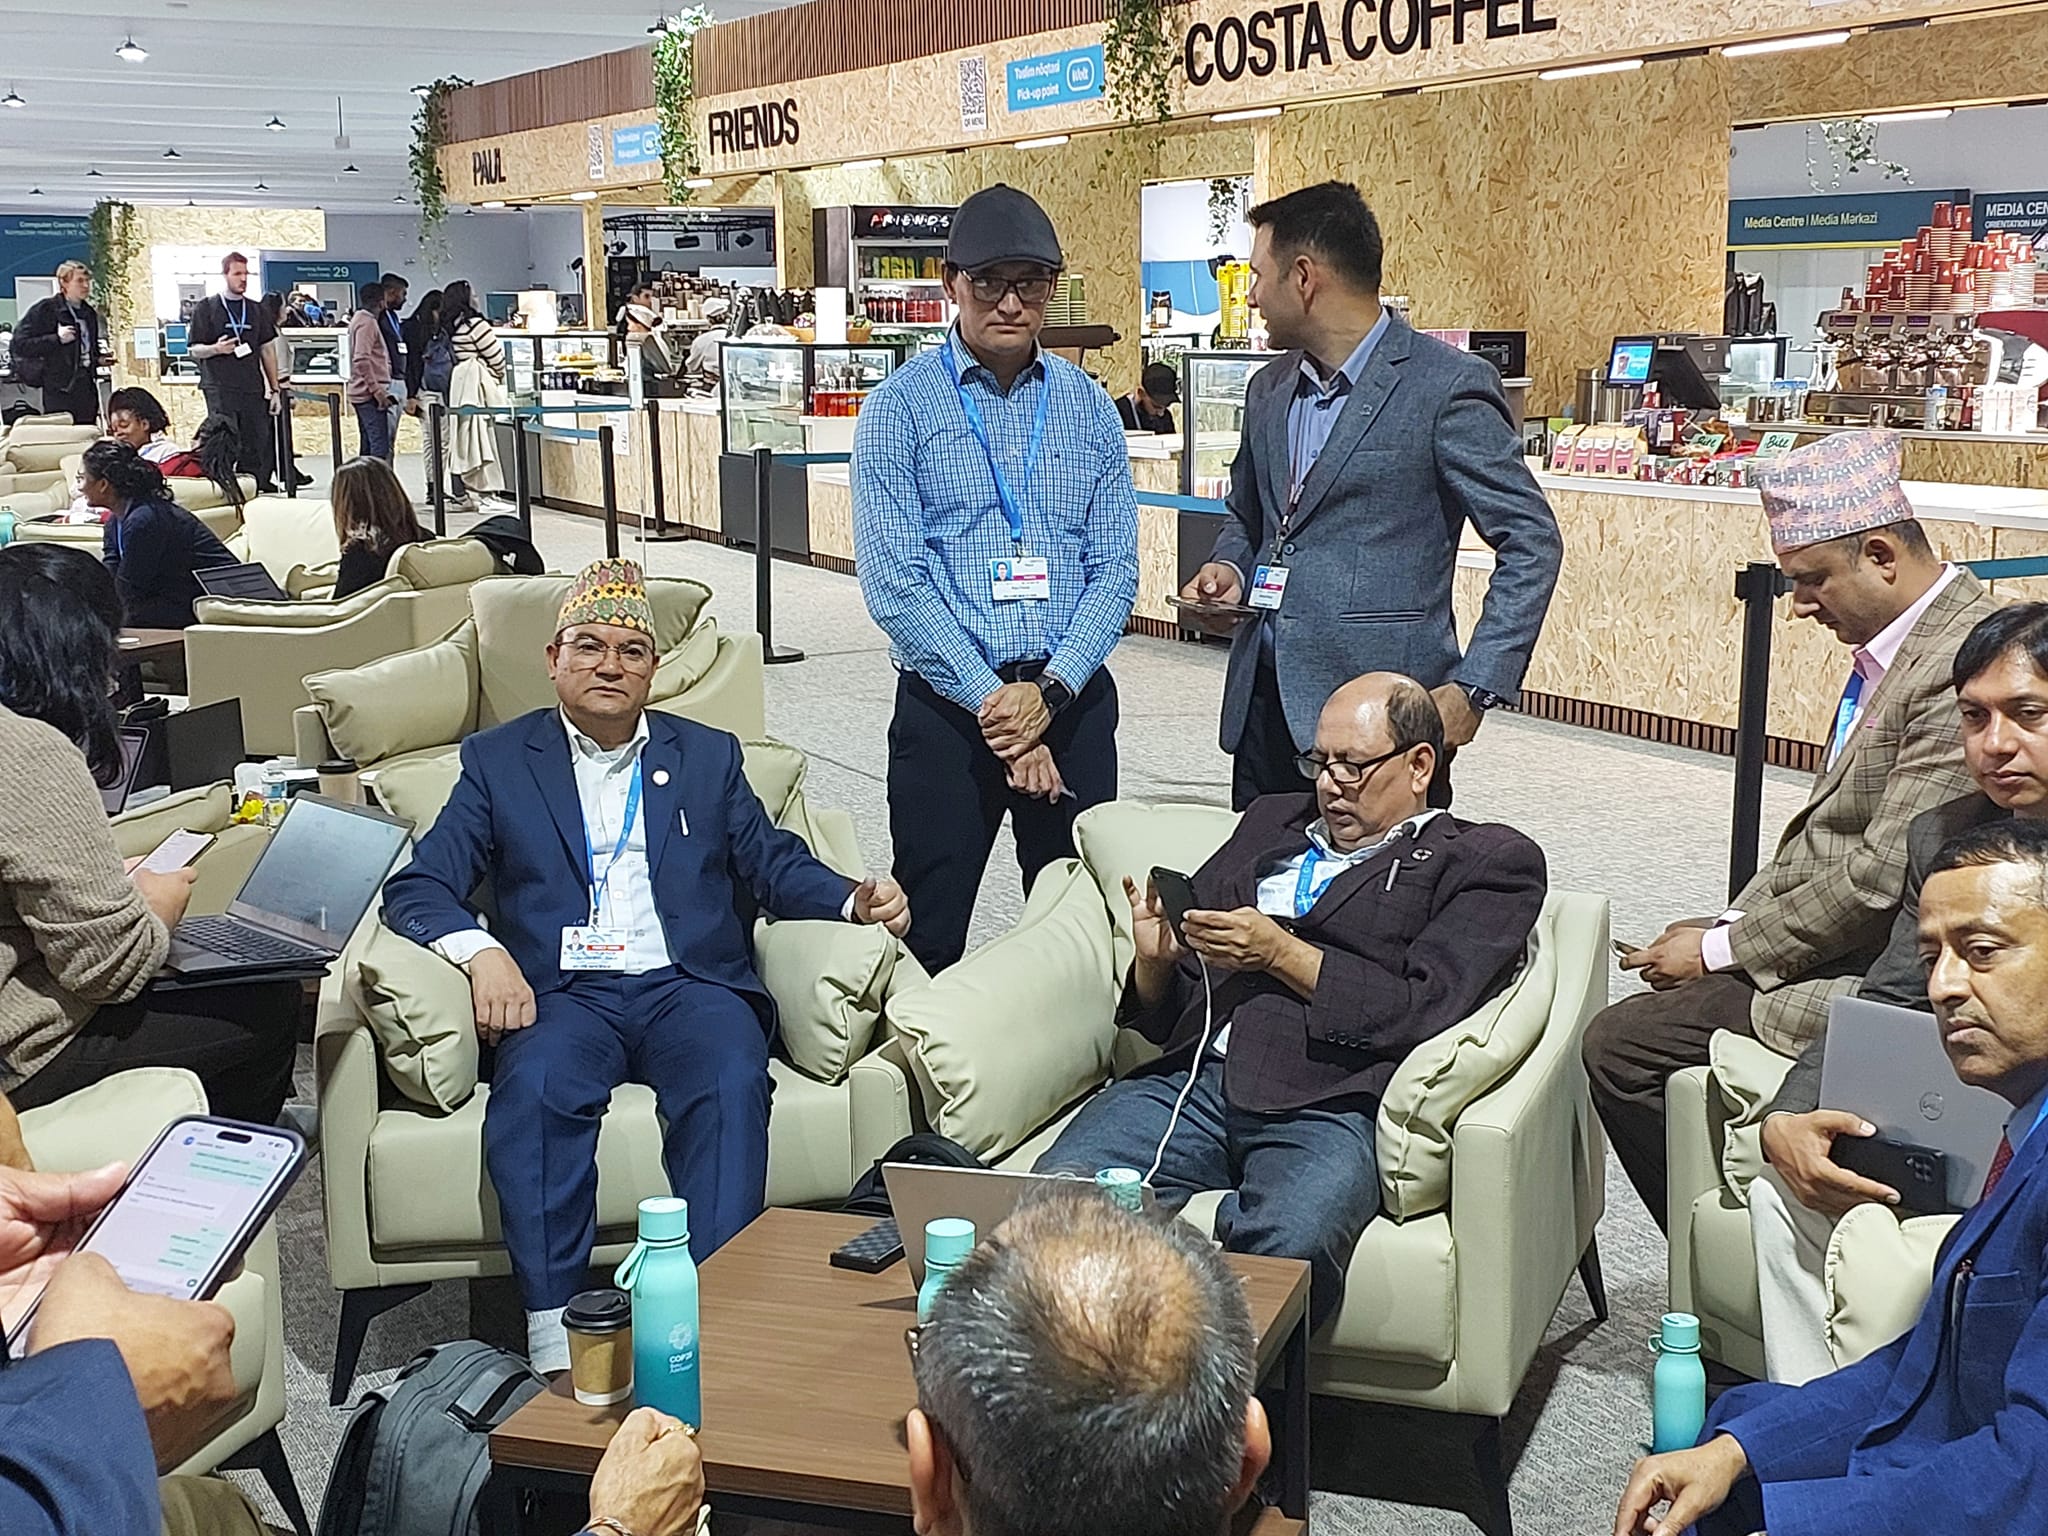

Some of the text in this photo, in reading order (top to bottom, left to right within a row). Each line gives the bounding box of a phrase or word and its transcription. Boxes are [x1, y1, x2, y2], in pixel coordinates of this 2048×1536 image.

[1184, 1, 1332, 86] COSTA
[708, 98, 800, 156] FRIENDS
[472, 148, 507, 187] PAUL
[1744, 216, 1772, 229] Media
[1773, 215, 1804, 228] Centre
[1810, 213, 1839, 226] Media
[1985, 202, 2025, 217] MEDIA
[332, 266, 350, 278] 29
